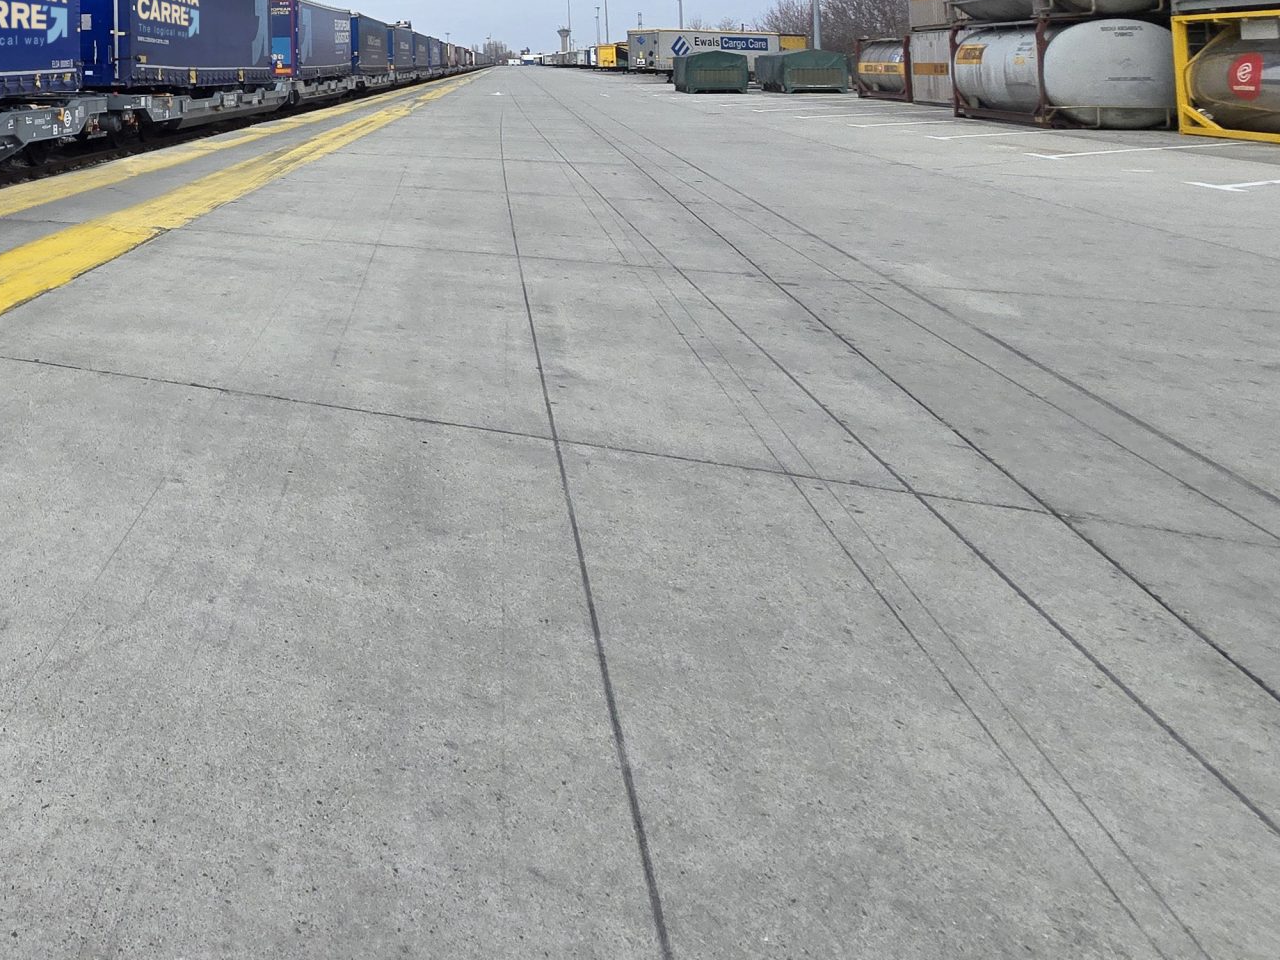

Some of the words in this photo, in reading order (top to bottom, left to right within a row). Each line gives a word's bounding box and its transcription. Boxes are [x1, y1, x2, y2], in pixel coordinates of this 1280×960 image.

[138, 23, 151, 33] The
[154, 25, 176, 37] logical
[24, 37, 45, 47] way
[694, 36, 720, 47] Ewals
[722, 38, 746, 49] Cargo
[748, 39, 767, 49] Care
